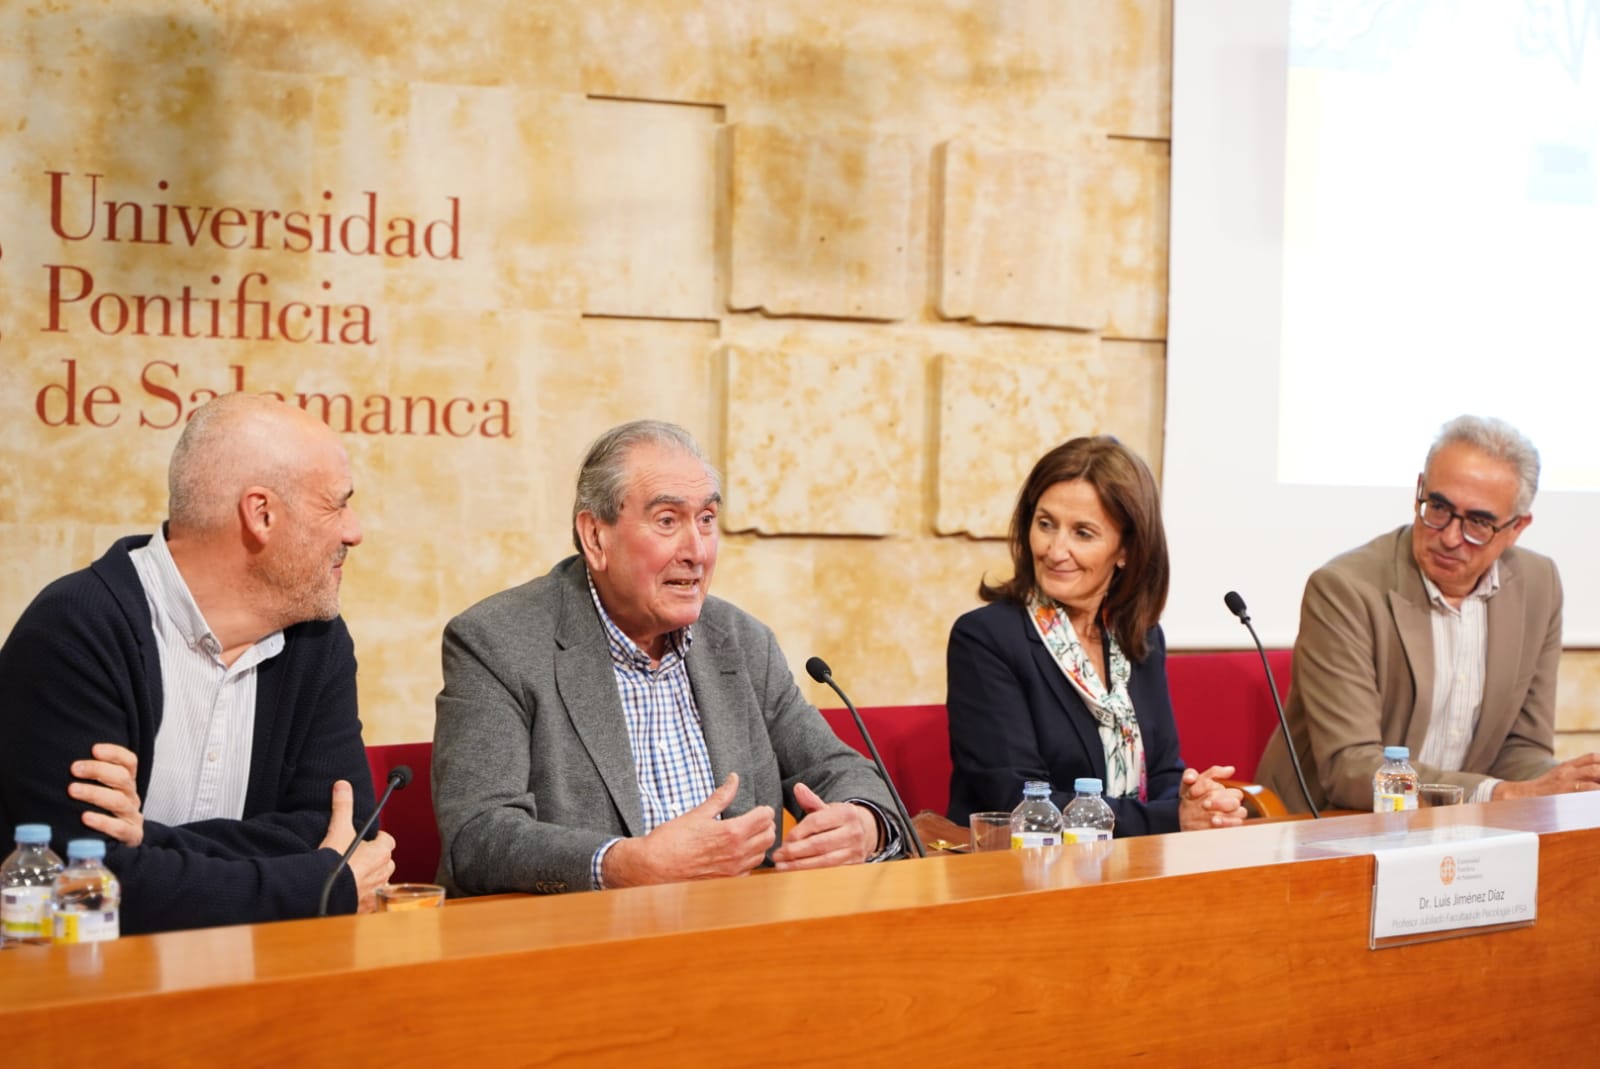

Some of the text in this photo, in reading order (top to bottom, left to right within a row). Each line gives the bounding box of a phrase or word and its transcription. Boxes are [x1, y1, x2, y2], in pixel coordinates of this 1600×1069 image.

[45, 171, 463, 261] Universidad
[40, 265, 377, 345] Pontificia
[35, 359, 516, 439] de Smanca
[1419, 897, 1432, 910] Dr.
[1434, 895, 1451, 908] Luis
